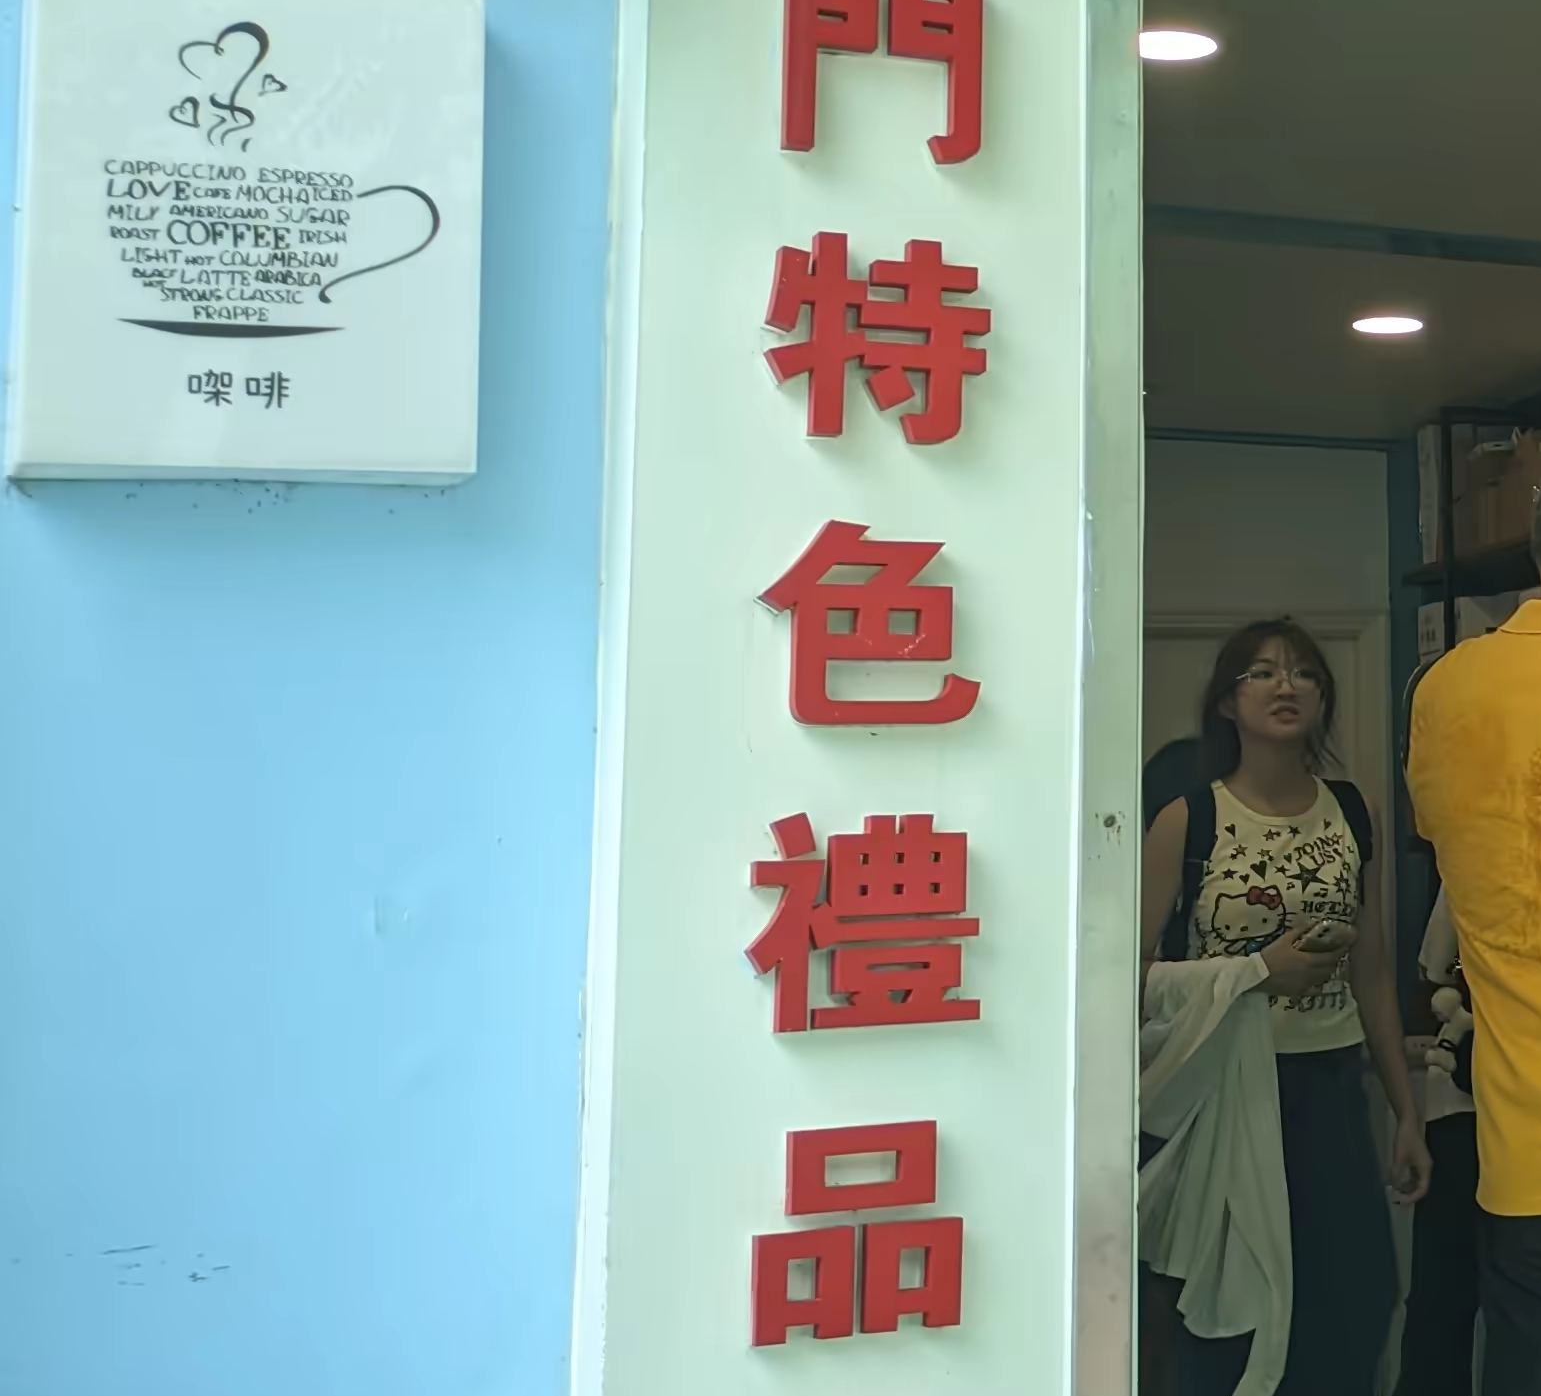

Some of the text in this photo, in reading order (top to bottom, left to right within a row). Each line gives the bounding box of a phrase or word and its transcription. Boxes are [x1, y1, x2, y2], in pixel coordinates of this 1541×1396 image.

[104, 158, 354, 188] CAPPUCCINO ESPRESSO
[107, 179, 192, 201] LOVE
[235, 185, 309, 204] MOCHA
[312, 187, 354, 203] ICED
[169, 204, 269, 220] AMERICANO
[275, 206, 351, 226] SUGAR
[109, 219, 347, 250] ROAST COFFEE IRISH
[120, 247, 182, 264] LIGHT
[219, 250, 338, 268] COLUMBIAN
[180, 268, 250, 285] LATTE
[254, 269, 322, 286] ARABICA
[226, 287, 304, 304] CLASSIC
[193, 305, 270, 321] FRAPPE
